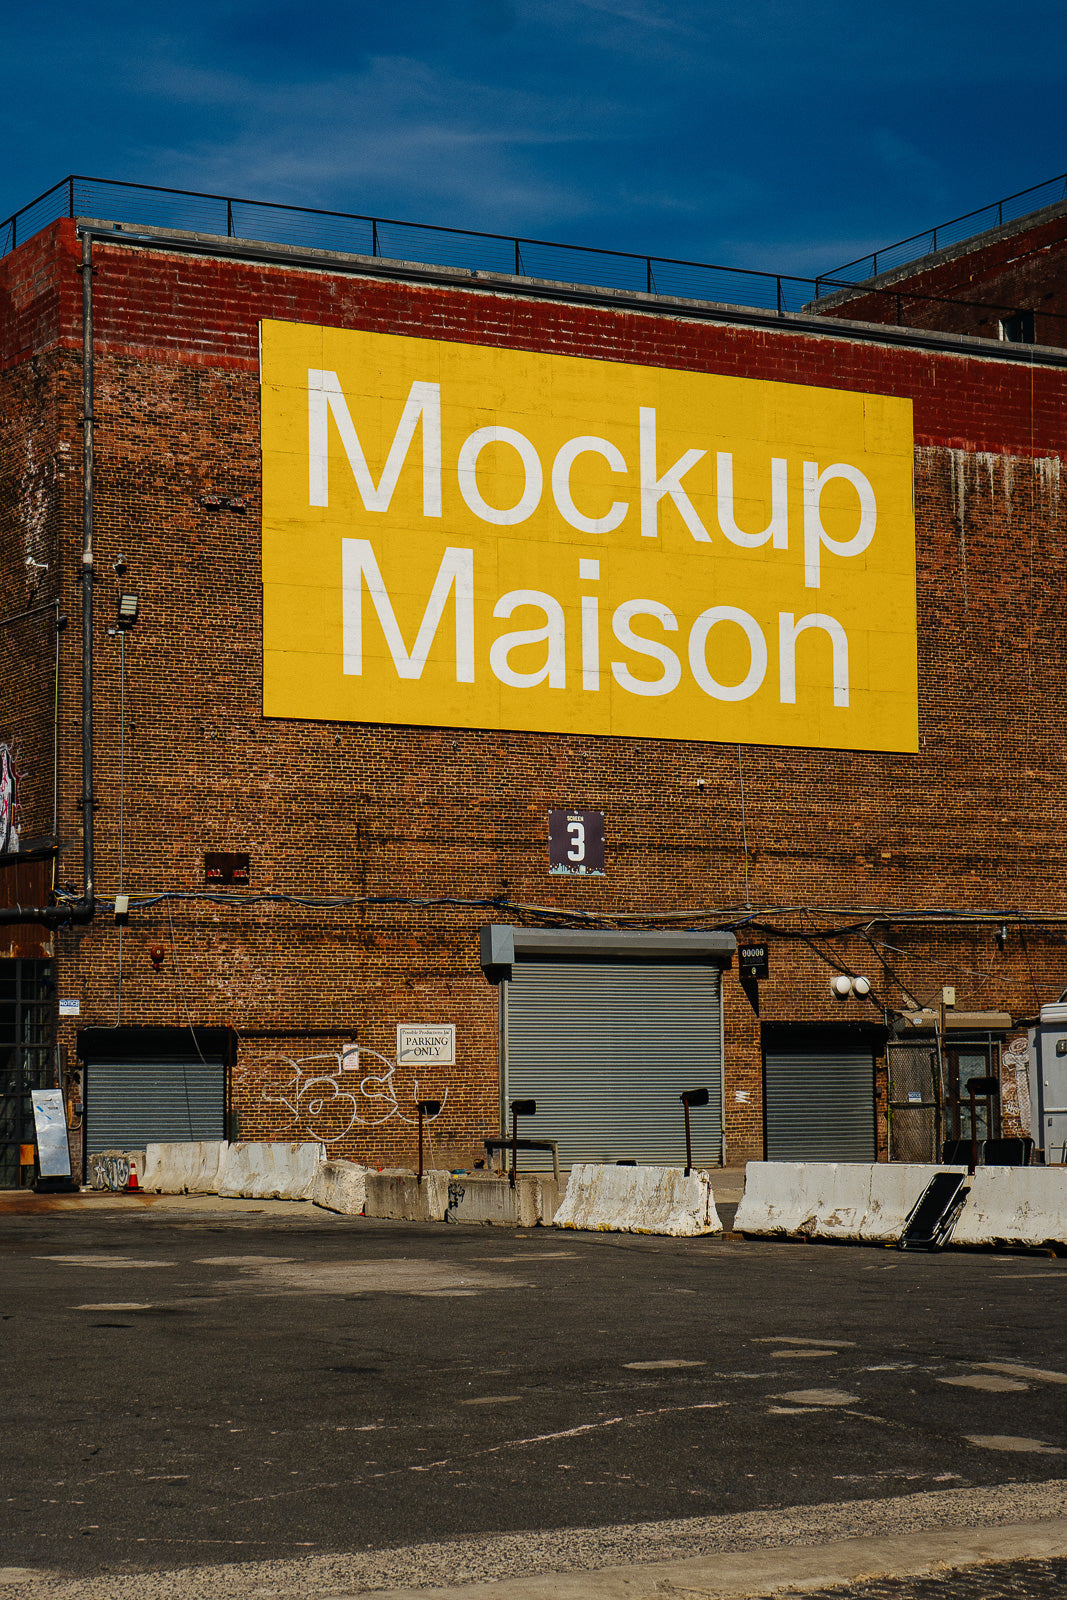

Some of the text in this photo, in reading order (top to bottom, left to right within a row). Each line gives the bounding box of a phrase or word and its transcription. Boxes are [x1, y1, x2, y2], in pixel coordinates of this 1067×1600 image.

[307, 368, 877, 588] Mockup
[342, 537, 850, 708] Maison
[567, 822, 585, 862] 3
[406, 1037, 449, 1046] PARKING
[413, 1047, 441, 1056] ONLY
